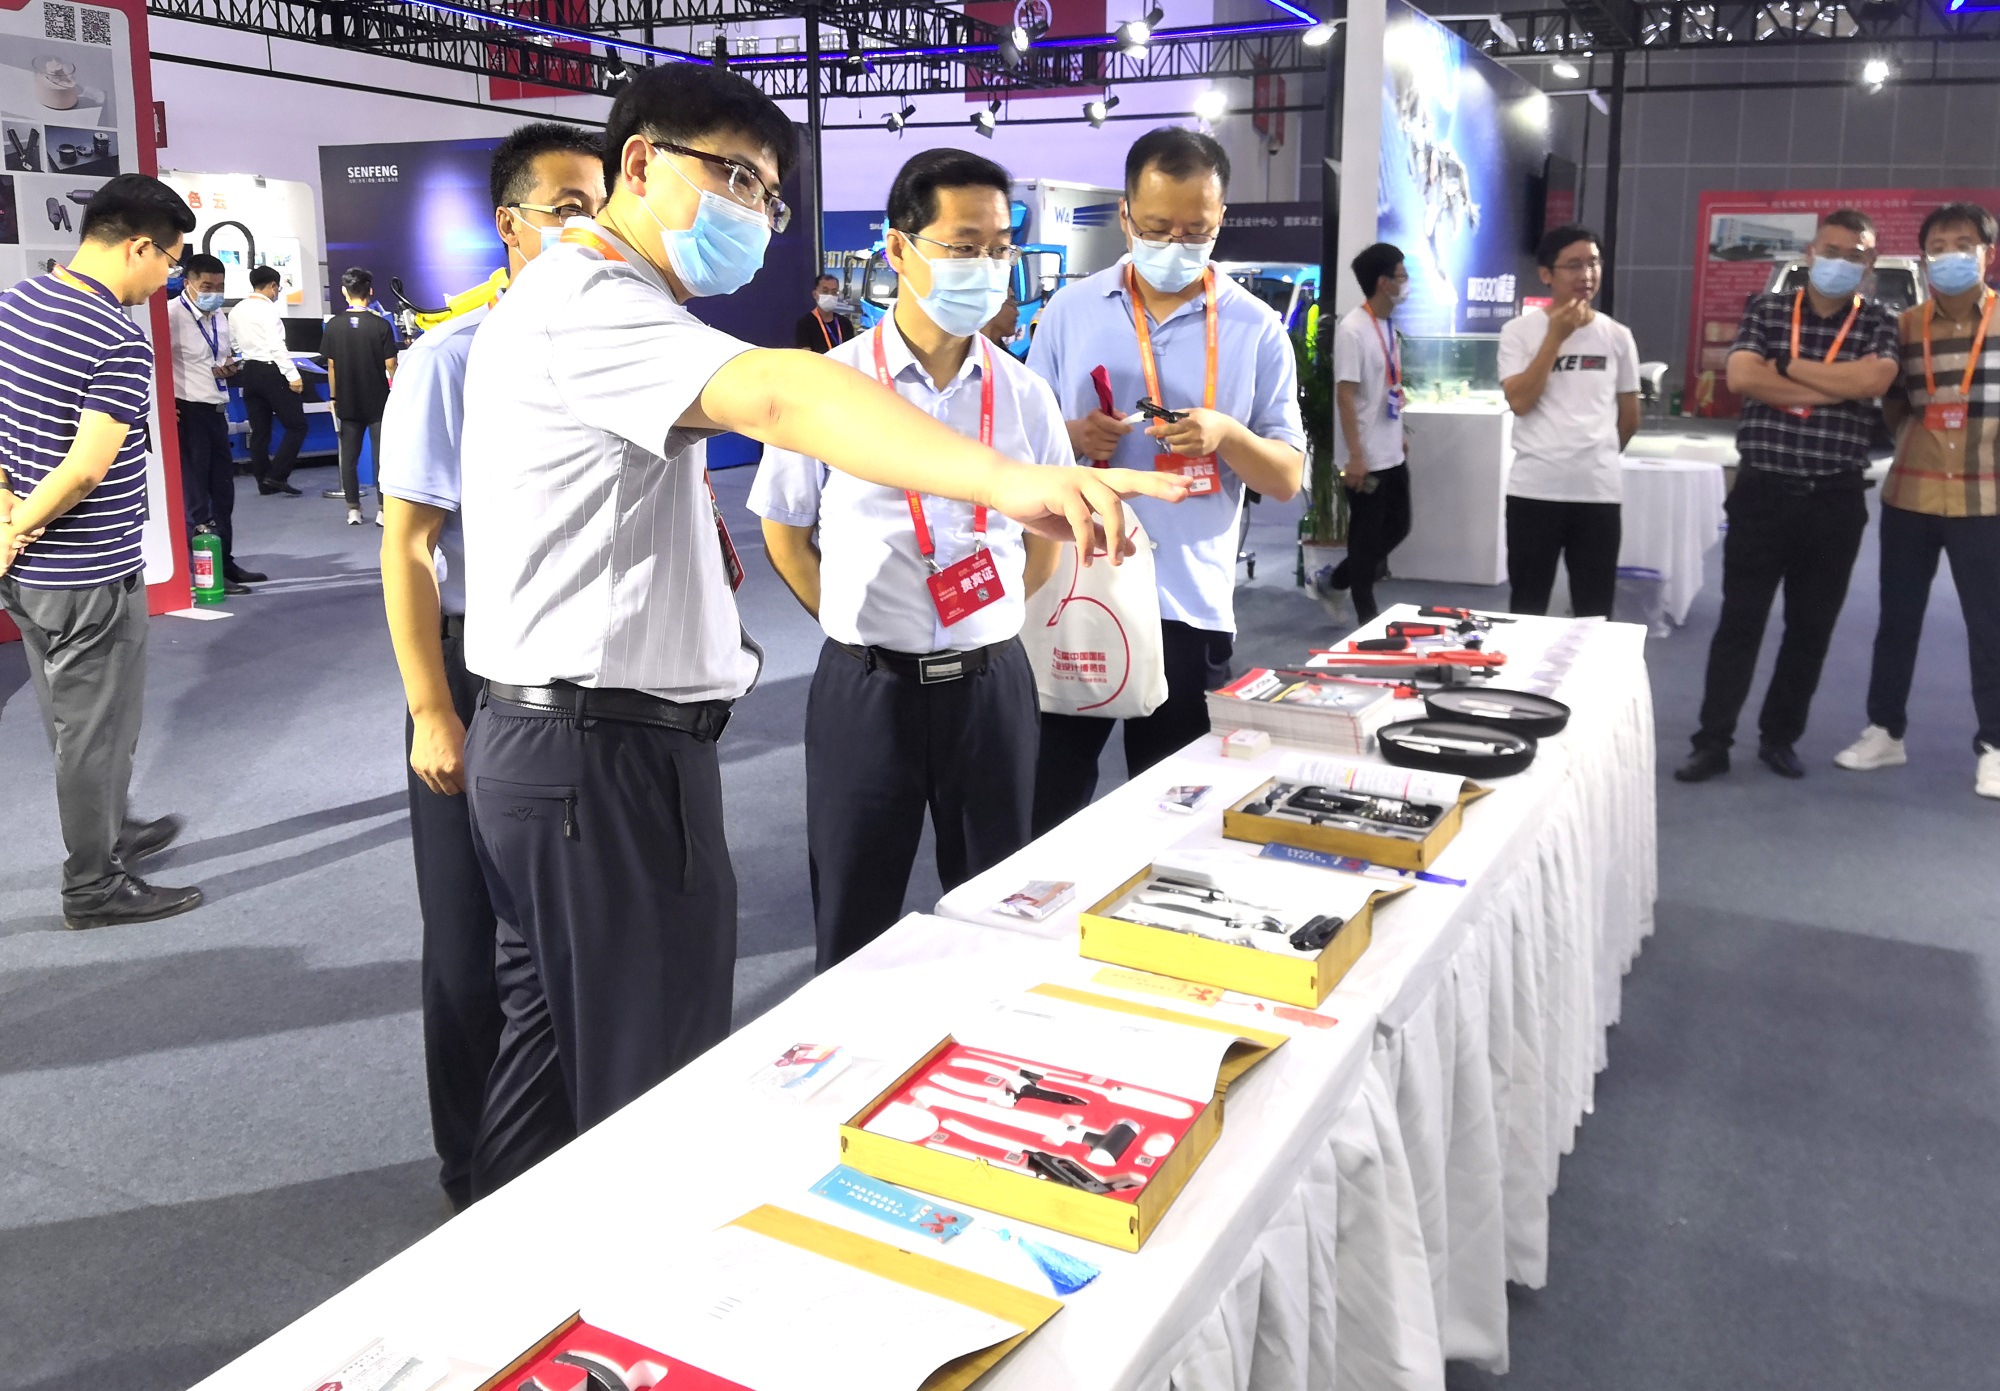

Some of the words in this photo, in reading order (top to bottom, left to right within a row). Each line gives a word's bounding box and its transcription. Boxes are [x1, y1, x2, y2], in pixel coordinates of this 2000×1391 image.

[347, 165, 398, 178] SENFENG
[1054, 206, 1070, 224] W4
[960, 566, 995, 593] 贵宾证
